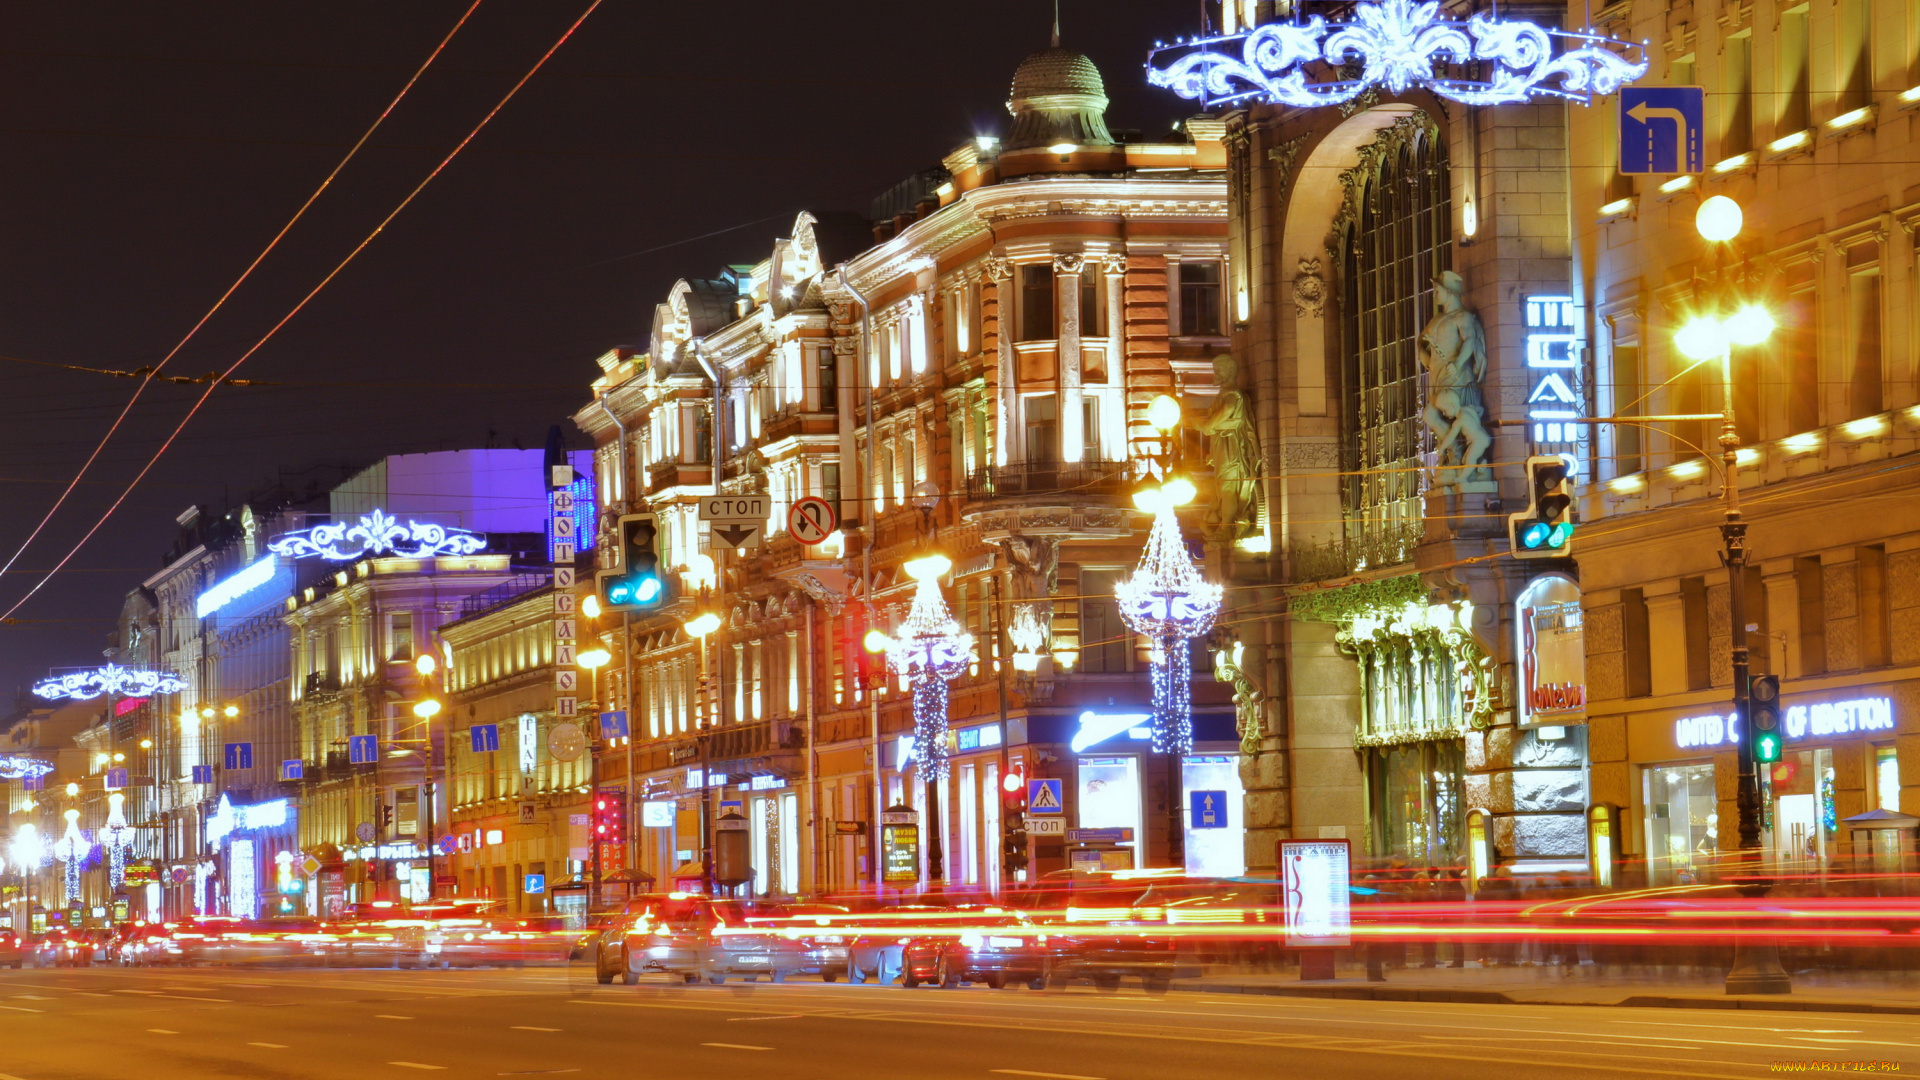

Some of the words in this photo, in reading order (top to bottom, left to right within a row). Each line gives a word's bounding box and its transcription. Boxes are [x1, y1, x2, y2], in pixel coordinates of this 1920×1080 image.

[709, 500, 762, 515] СТОП
[554, 492, 576, 715] ФОТОСАЛОН
[1786, 706, 1807, 737] OF
[1811, 698, 1893, 735] BENETTON
[1676, 715, 1723, 747] UNITED
[894, 828, 917, 836] МУЗЕЙ
[1023, 821, 1059, 832] СТОП
